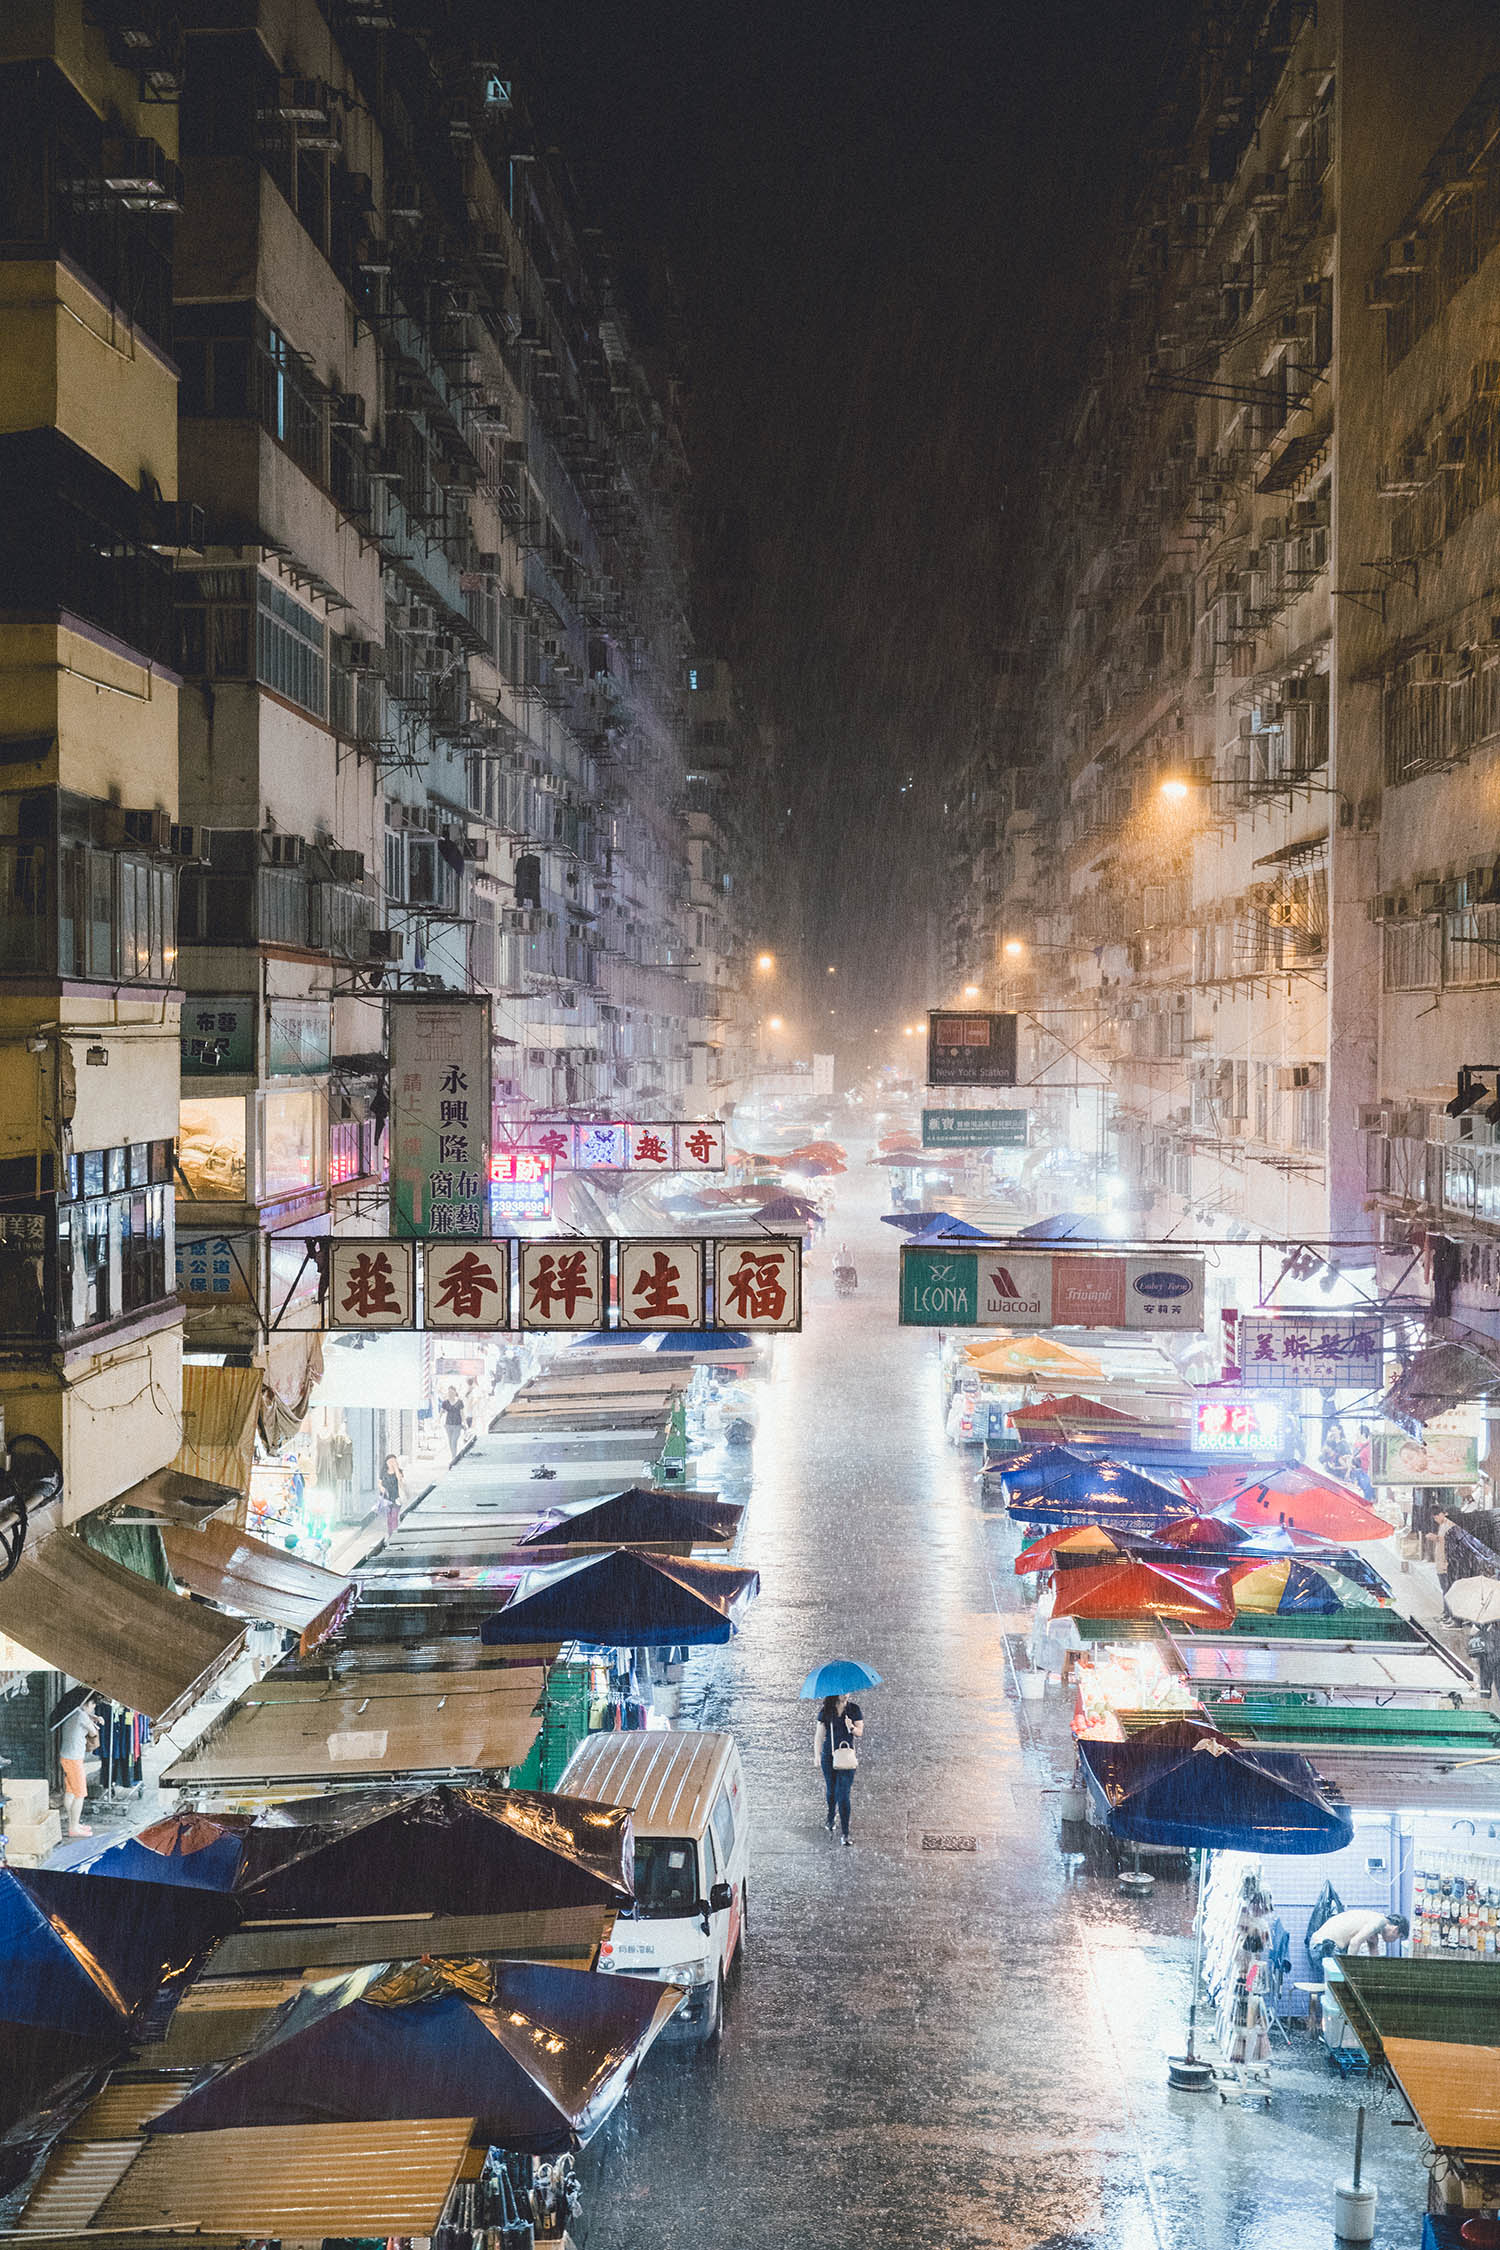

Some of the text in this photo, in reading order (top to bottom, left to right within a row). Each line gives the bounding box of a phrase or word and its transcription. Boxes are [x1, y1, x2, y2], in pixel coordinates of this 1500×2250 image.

[958, 1068, 977, 1077] York
[439, 1065, 469, 1164] 永興隆
[914, 1286, 968, 1313] LEONA
[1065, 1287, 1113, 1303] Triumph
[987, 1298, 1041, 1313] Wacoal
[1143, 1304, 1182, 1314] 安莉芳
